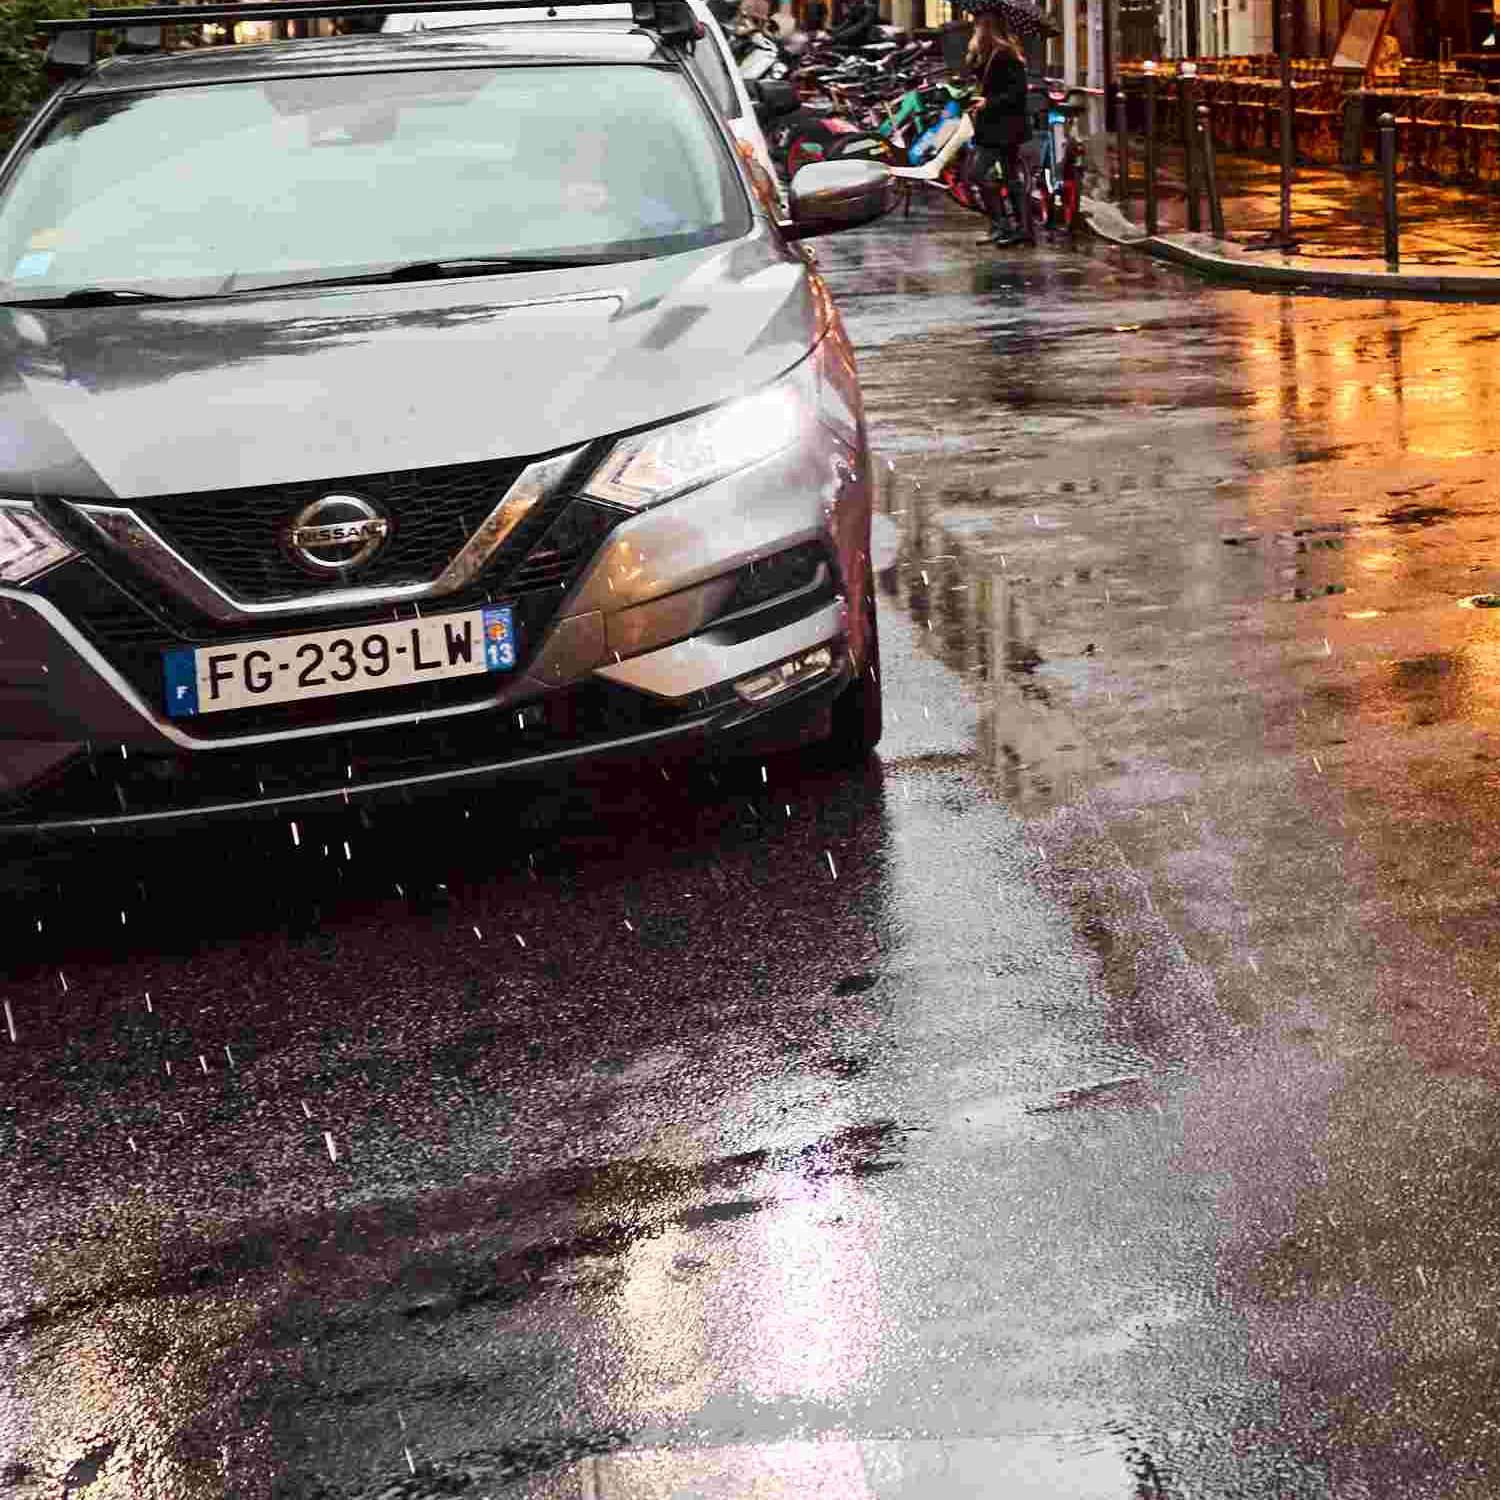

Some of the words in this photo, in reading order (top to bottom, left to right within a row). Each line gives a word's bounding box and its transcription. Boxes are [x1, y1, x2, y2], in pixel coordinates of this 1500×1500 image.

[297, 524, 377, 544] NISSAN
[207, 620, 473, 700] FG-239-LW
[490, 642, 514, 664] 13
[176, 685, 188, 700] F
